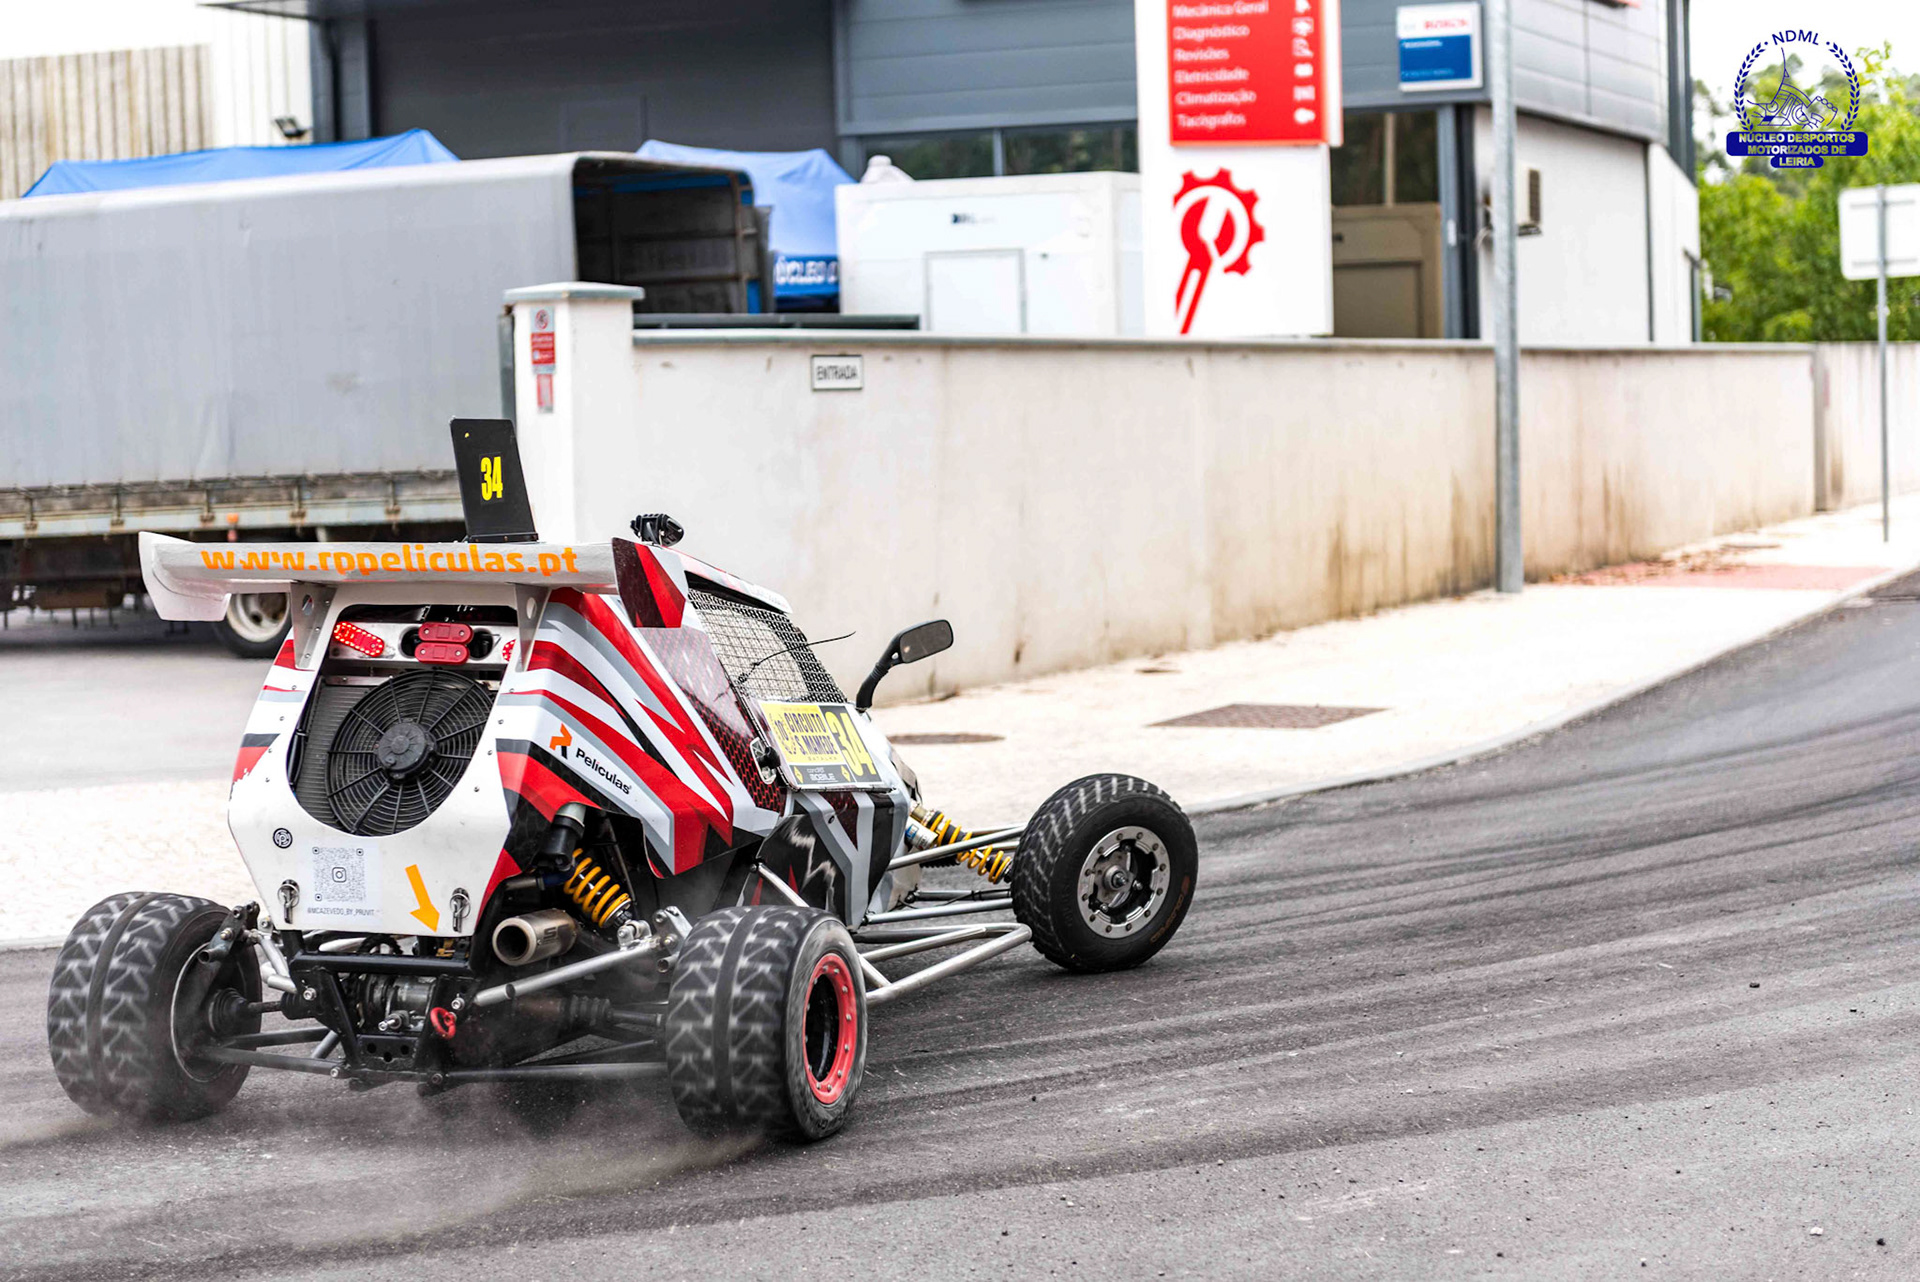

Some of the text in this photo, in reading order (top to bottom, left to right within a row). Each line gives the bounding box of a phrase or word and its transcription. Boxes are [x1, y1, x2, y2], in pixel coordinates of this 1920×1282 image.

[1234, 0, 1269, 14] Geral
[1174, 46, 1230, 61] Revisões
[480, 456, 504, 501] 34
[825, 711, 876, 776] 34
